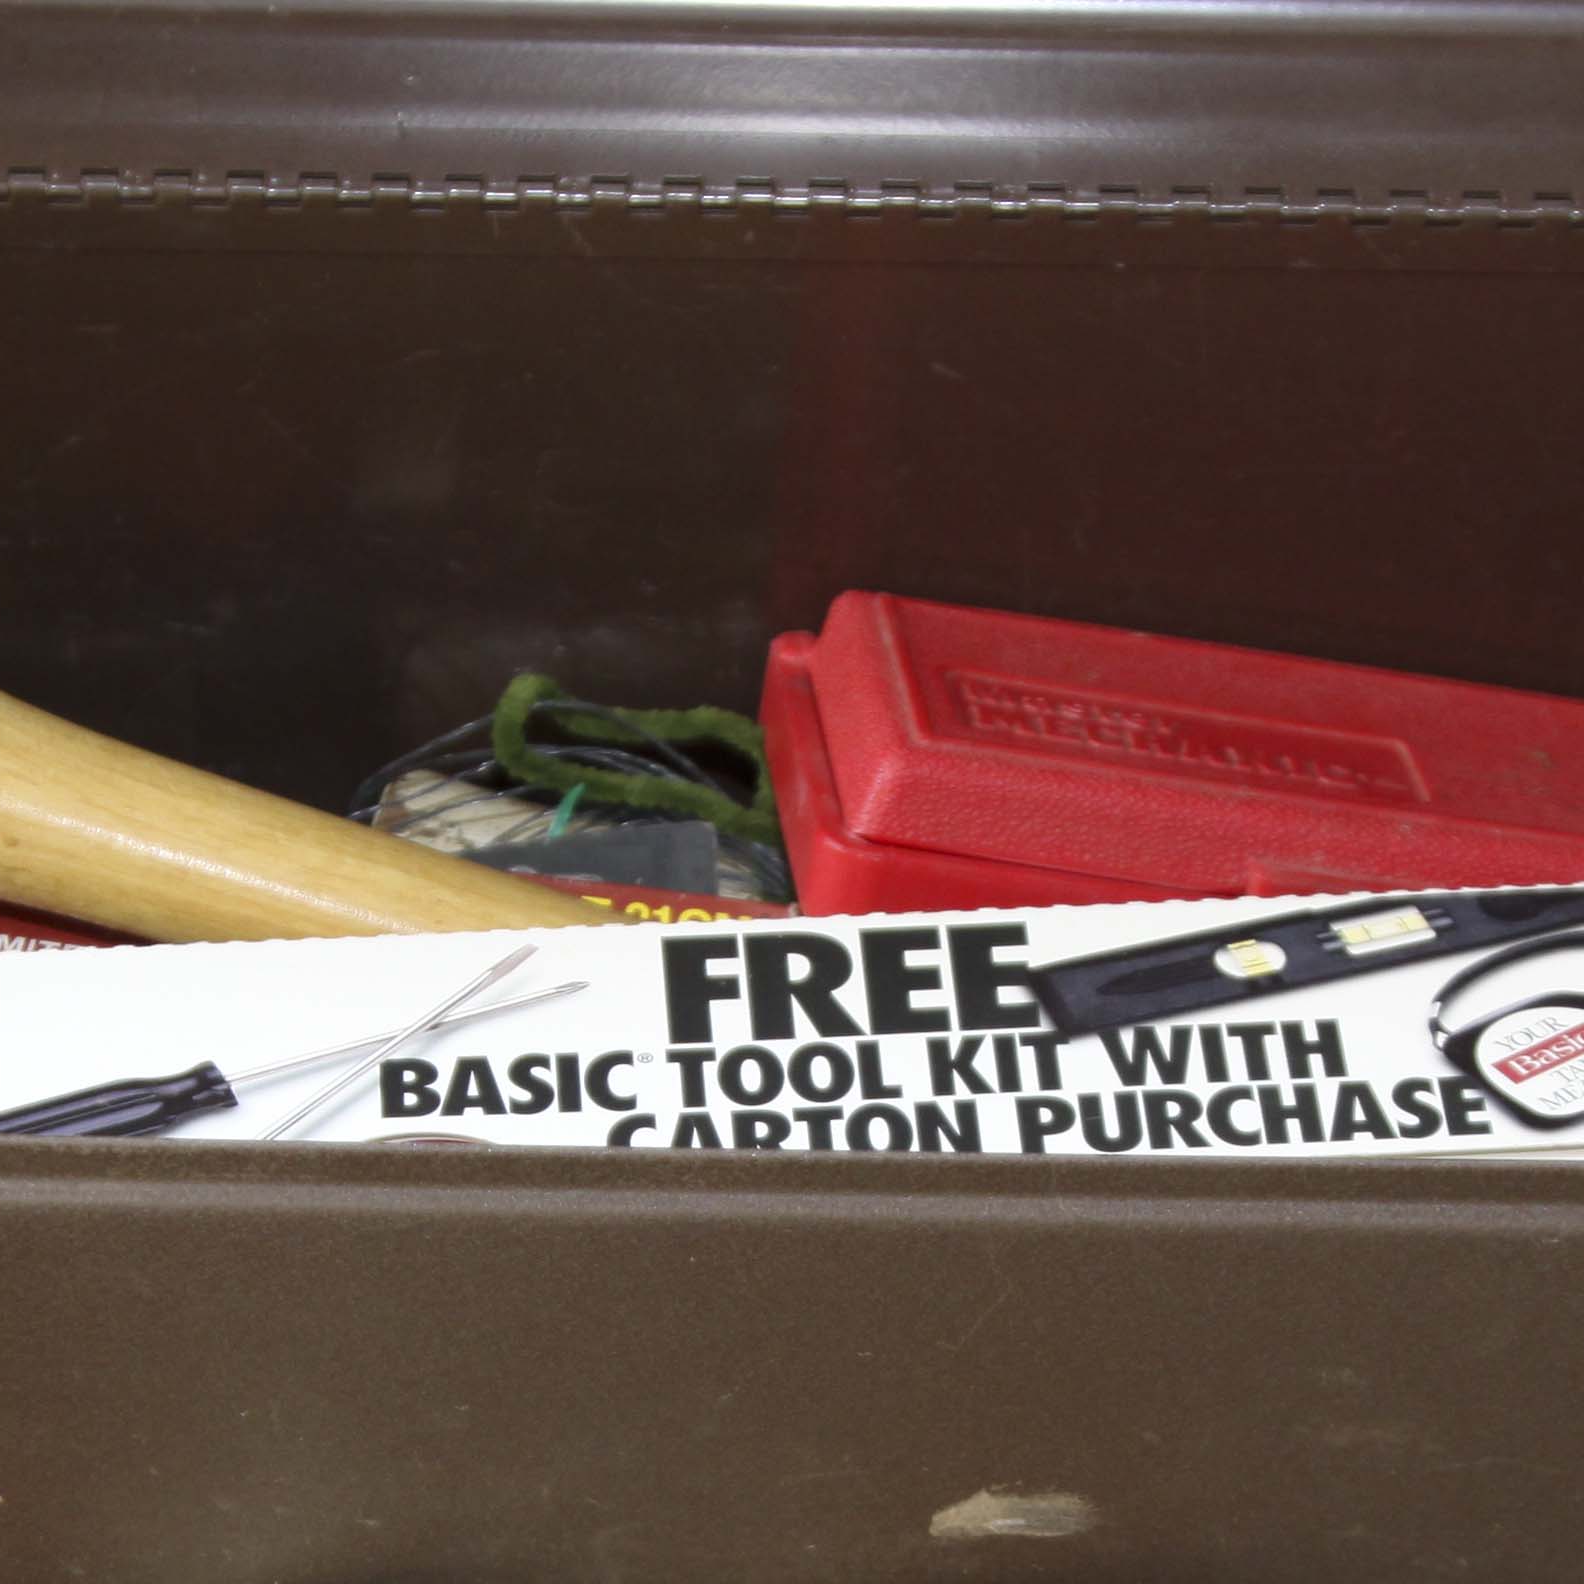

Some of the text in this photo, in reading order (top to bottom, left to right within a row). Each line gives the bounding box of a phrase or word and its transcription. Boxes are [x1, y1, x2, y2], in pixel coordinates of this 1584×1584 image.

[660, 920, 1044, 1045] FREE
[379, 1018, 1350, 1119] BASIC TOOL KIT WITH
[1492, 1016, 1570, 1053] YOUR
[606, 1074, 1494, 1155] CARTON PURCHASE
